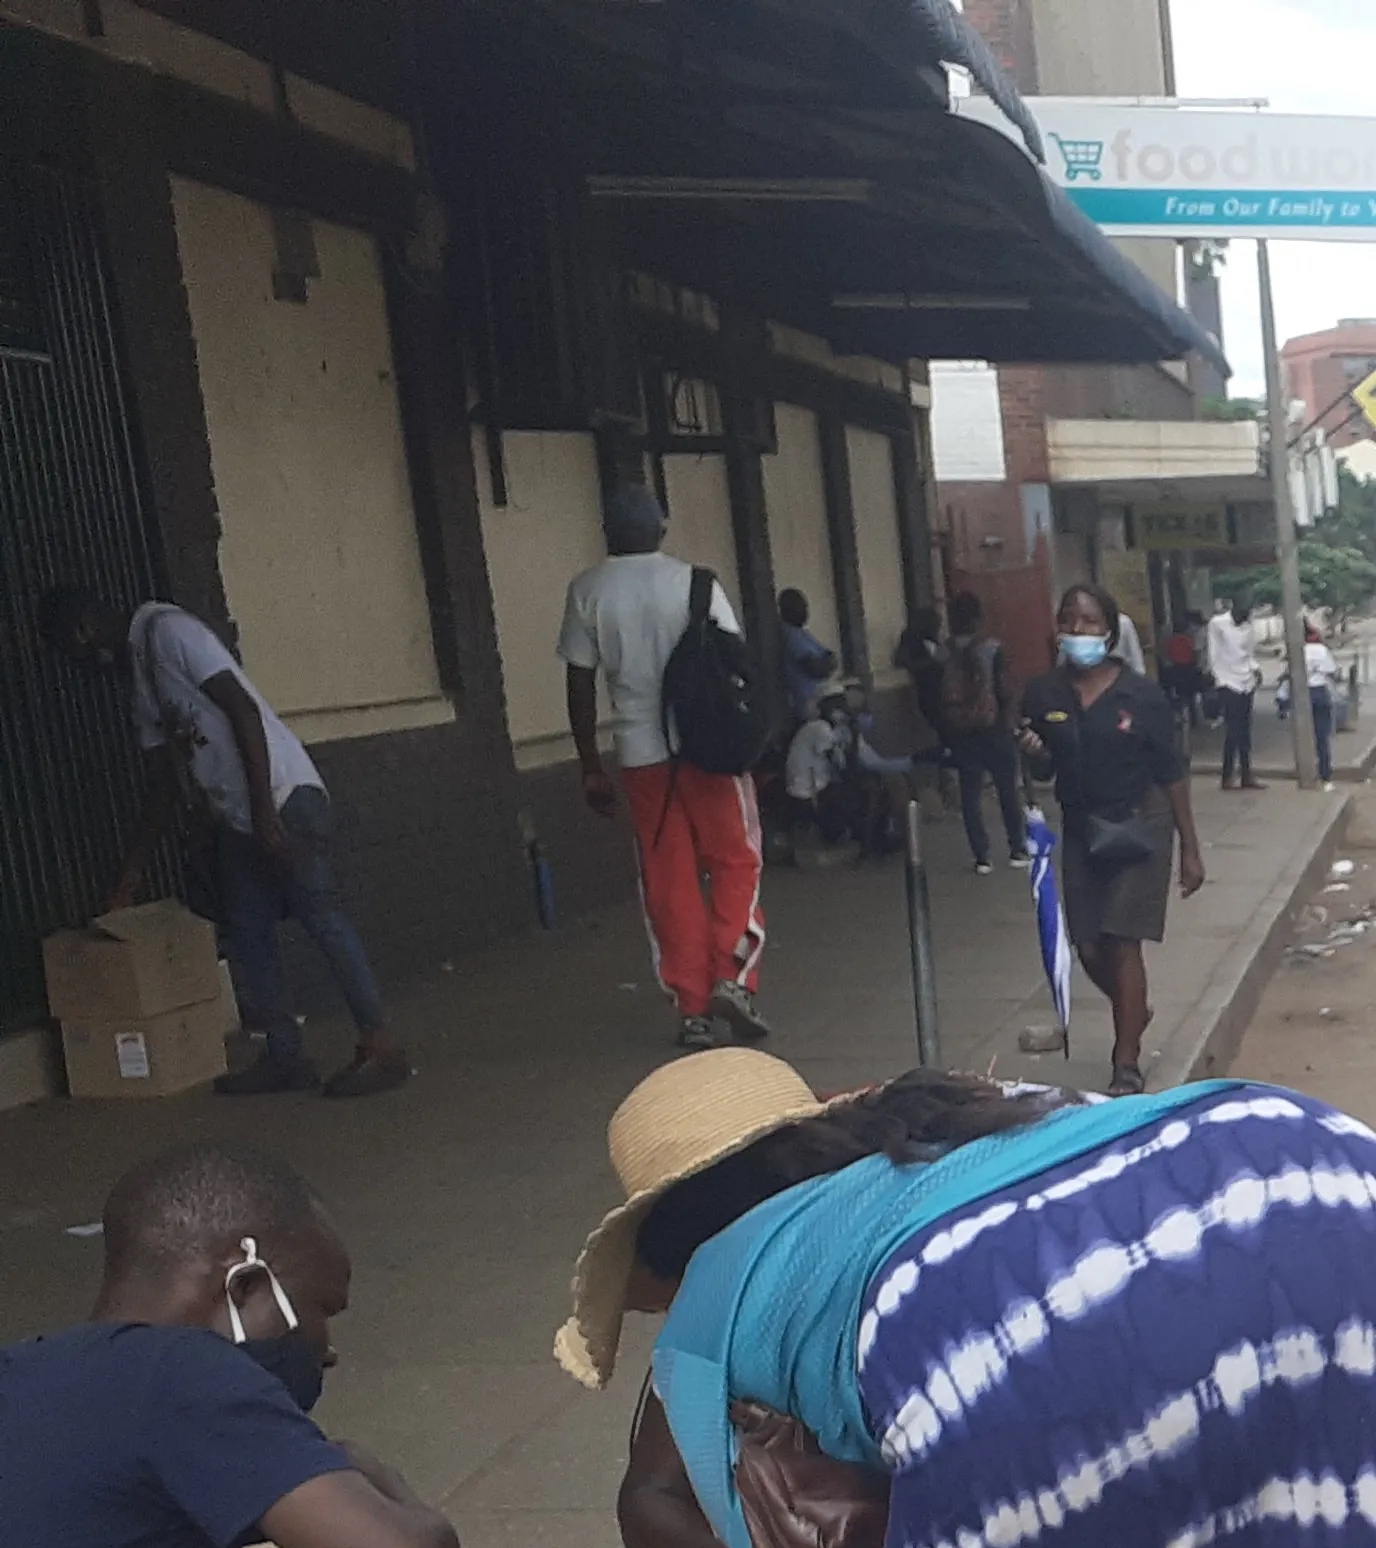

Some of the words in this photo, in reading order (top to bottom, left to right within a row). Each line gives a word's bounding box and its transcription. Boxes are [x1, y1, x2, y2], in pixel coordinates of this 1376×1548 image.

[1164, 196, 1216, 217] From
[1222, 197, 1260, 217] Our
[1267, 197, 1336, 224] Family
[1340, 201, 1362, 217] to
